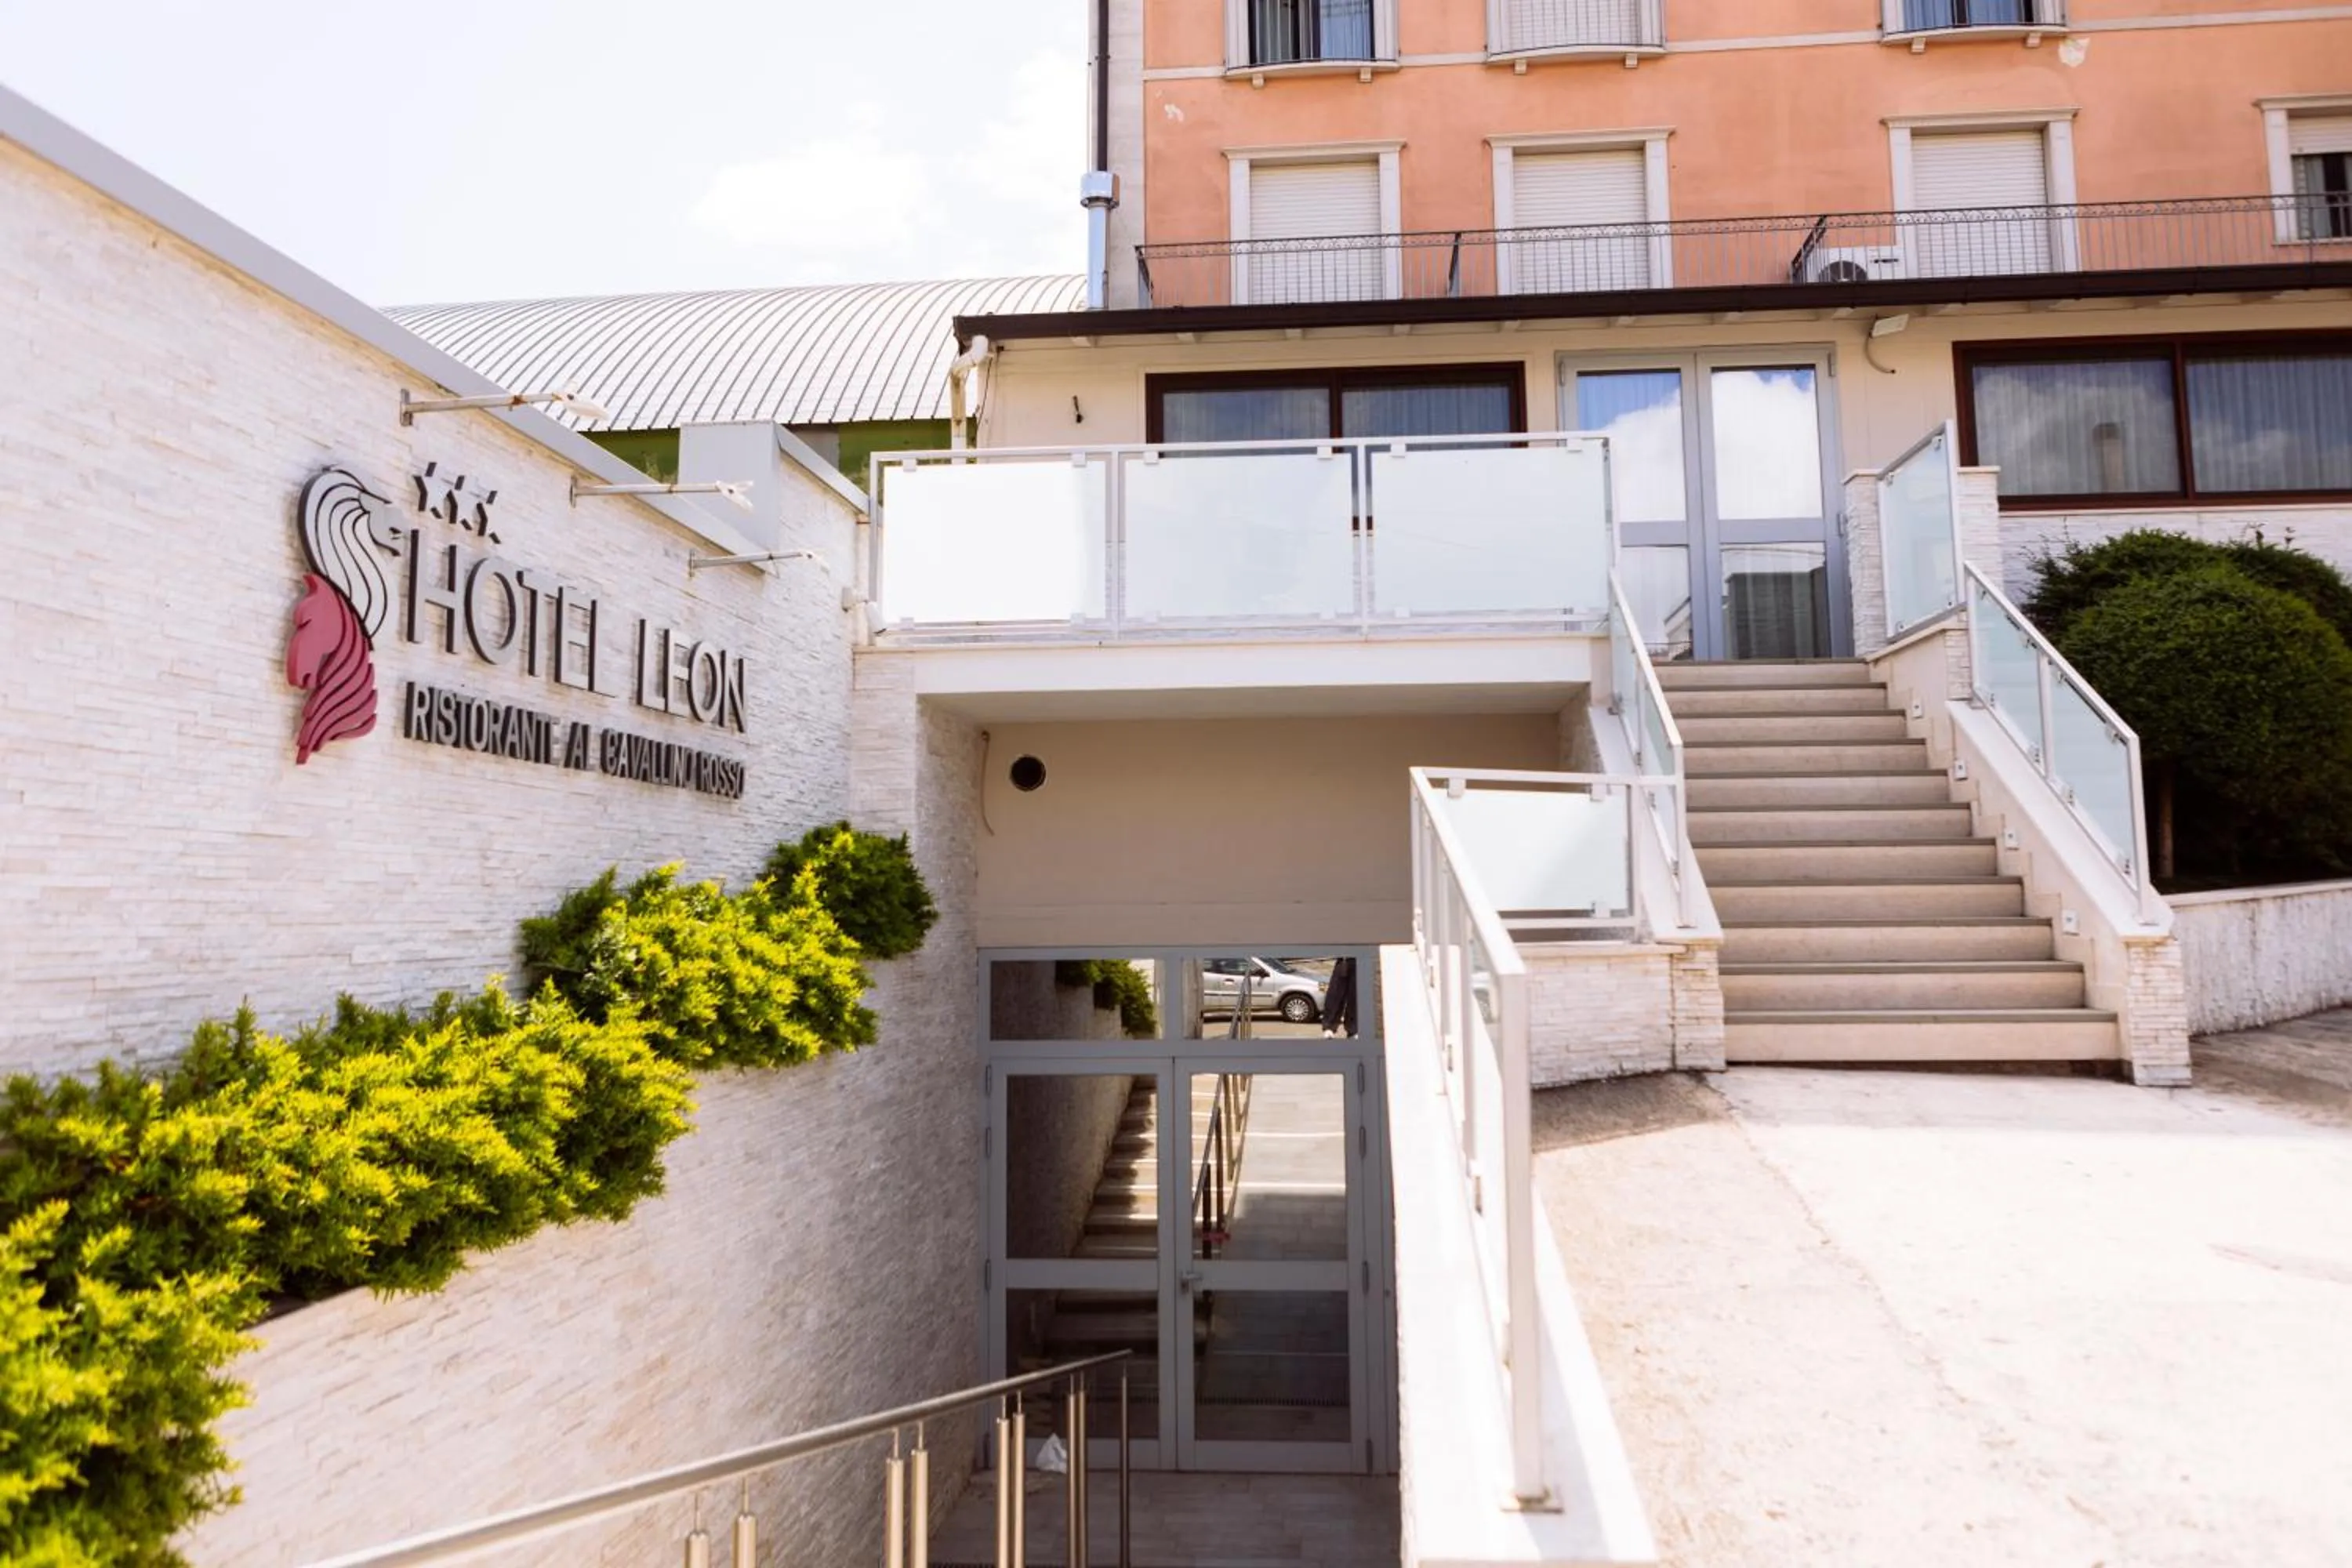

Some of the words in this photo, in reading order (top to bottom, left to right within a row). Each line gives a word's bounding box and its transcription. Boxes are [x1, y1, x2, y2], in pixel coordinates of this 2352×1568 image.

[407, 529, 617, 699] HOTEL
[637, 618, 748, 733] LEON
[404, 681, 561, 766] RISTORANTE
[564, 721, 603, 771] AL
[601, 728, 694, 788] CAVALLINO
[695, 750, 746, 799] ROSSO
